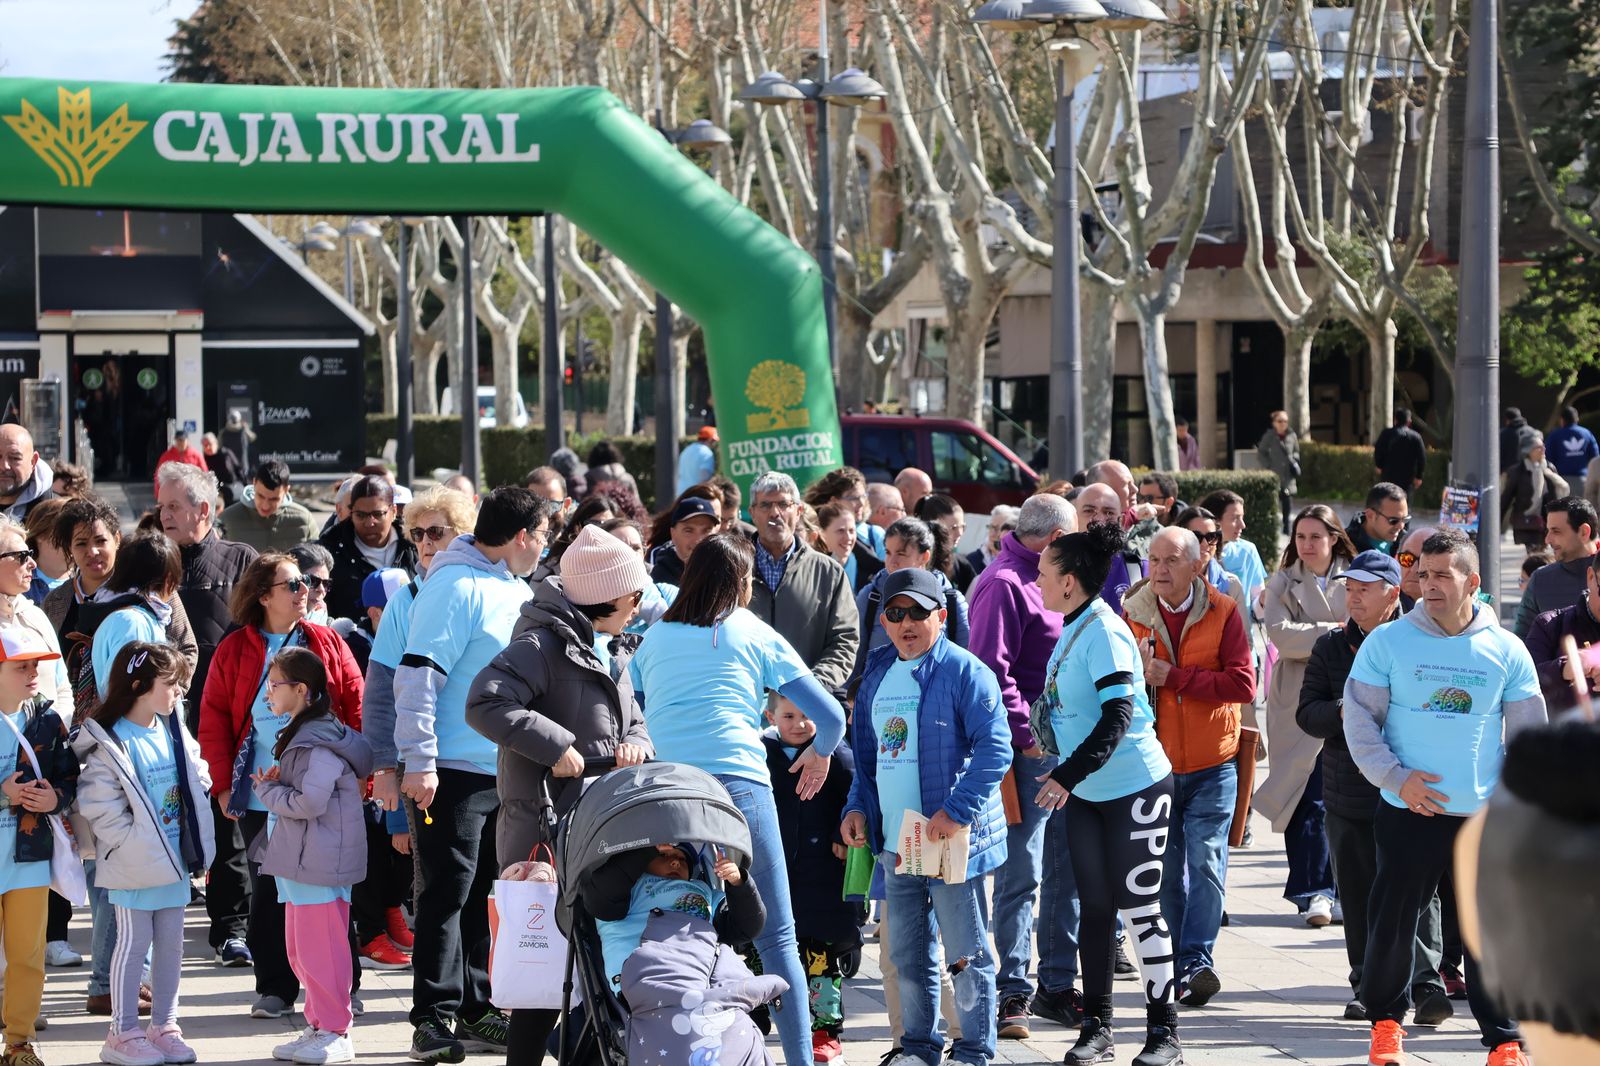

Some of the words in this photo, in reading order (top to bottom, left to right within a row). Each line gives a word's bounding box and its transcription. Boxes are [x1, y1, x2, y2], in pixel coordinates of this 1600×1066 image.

[153, 110, 312, 166] CAJA
[316, 113, 540, 164] RURAL
[730, 458, 770, 476] CAJA
[775, 450, 835, 470] RURAL
